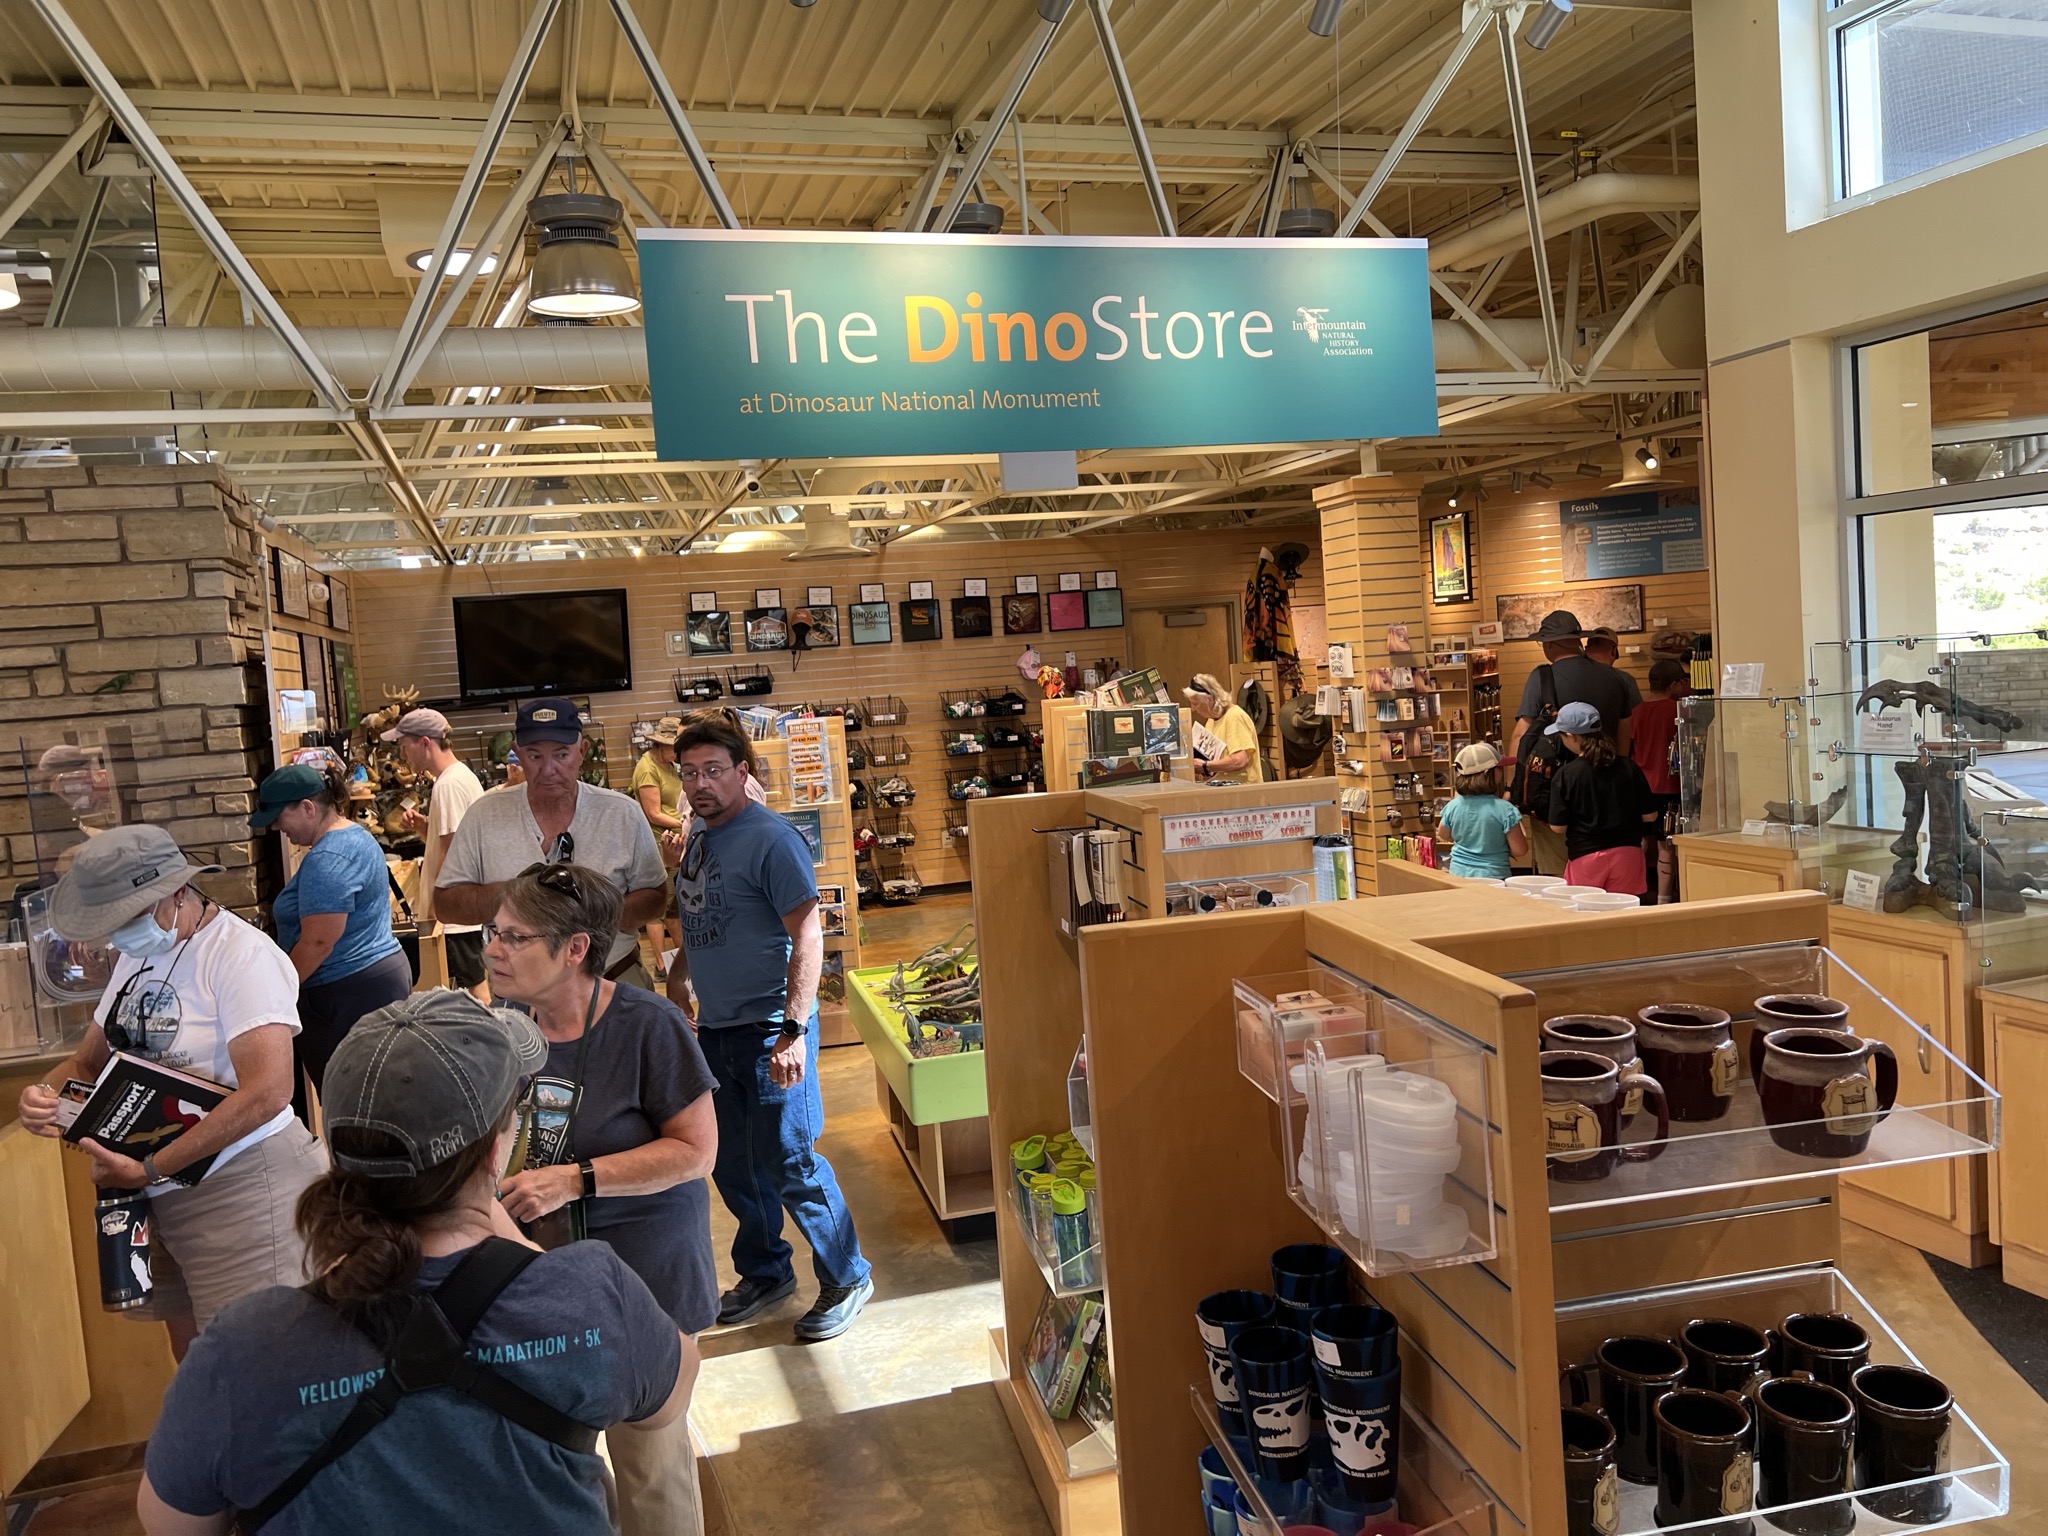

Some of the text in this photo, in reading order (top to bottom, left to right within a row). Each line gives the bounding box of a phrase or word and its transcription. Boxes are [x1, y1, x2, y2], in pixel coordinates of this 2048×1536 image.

[725, 289, 878, 364] The
[1292, 319, 1366, 331] Intermountain
[1322, 332, 1356, 340] NATURAL
[1329, 340, 1360, 348] HISTORY
[1323, 346, 1373, 356] Association
[739, 387, 1101, 413] at Dinosaur National Monument
[1571, 502, 1599, 513] Fossils
[851, 611, 889, 619] DINOSAUR
[1481, 625, 1495, 634] new
[749, 632, 786, 640] DINOSAUR
[1331, 664, 1344, 673] DINO
[789, 723, 819, 731] DINOSAUR
[1170, 817, 1230, 830] DISCOVER
[1236, 812, 1266, 823] YOUR
[1272, 809, 1311, 820] WORLD
[1228, 829, 1264, 843] COMPASS
[1280, 825, 1306, 838] SCOPE
[97, 1081, 146, 1139] Passport
[115, 1088, 157, 1143] To Your National Parks
[1547, 1141, 1586, 1149] DINOSAUR
[477, 1335, 567, 1365] MARATHON
[585, 1327, 602, 1348] 5K
[1335, 1369, 1374, 1378] MONUMENT
[1056, 1367, 1076, 1407] RangerLand
[1248, 1389, 1281, 1399] DINOSAUR
[1355, 1404, 1391, 1416] MONUMENT
[1258, 1450, 1299, 1459] INTERNATIONAL
[1366, 1470, 1378, 1479] SKY
[1377, 1469, 1391, 1478] PARK
